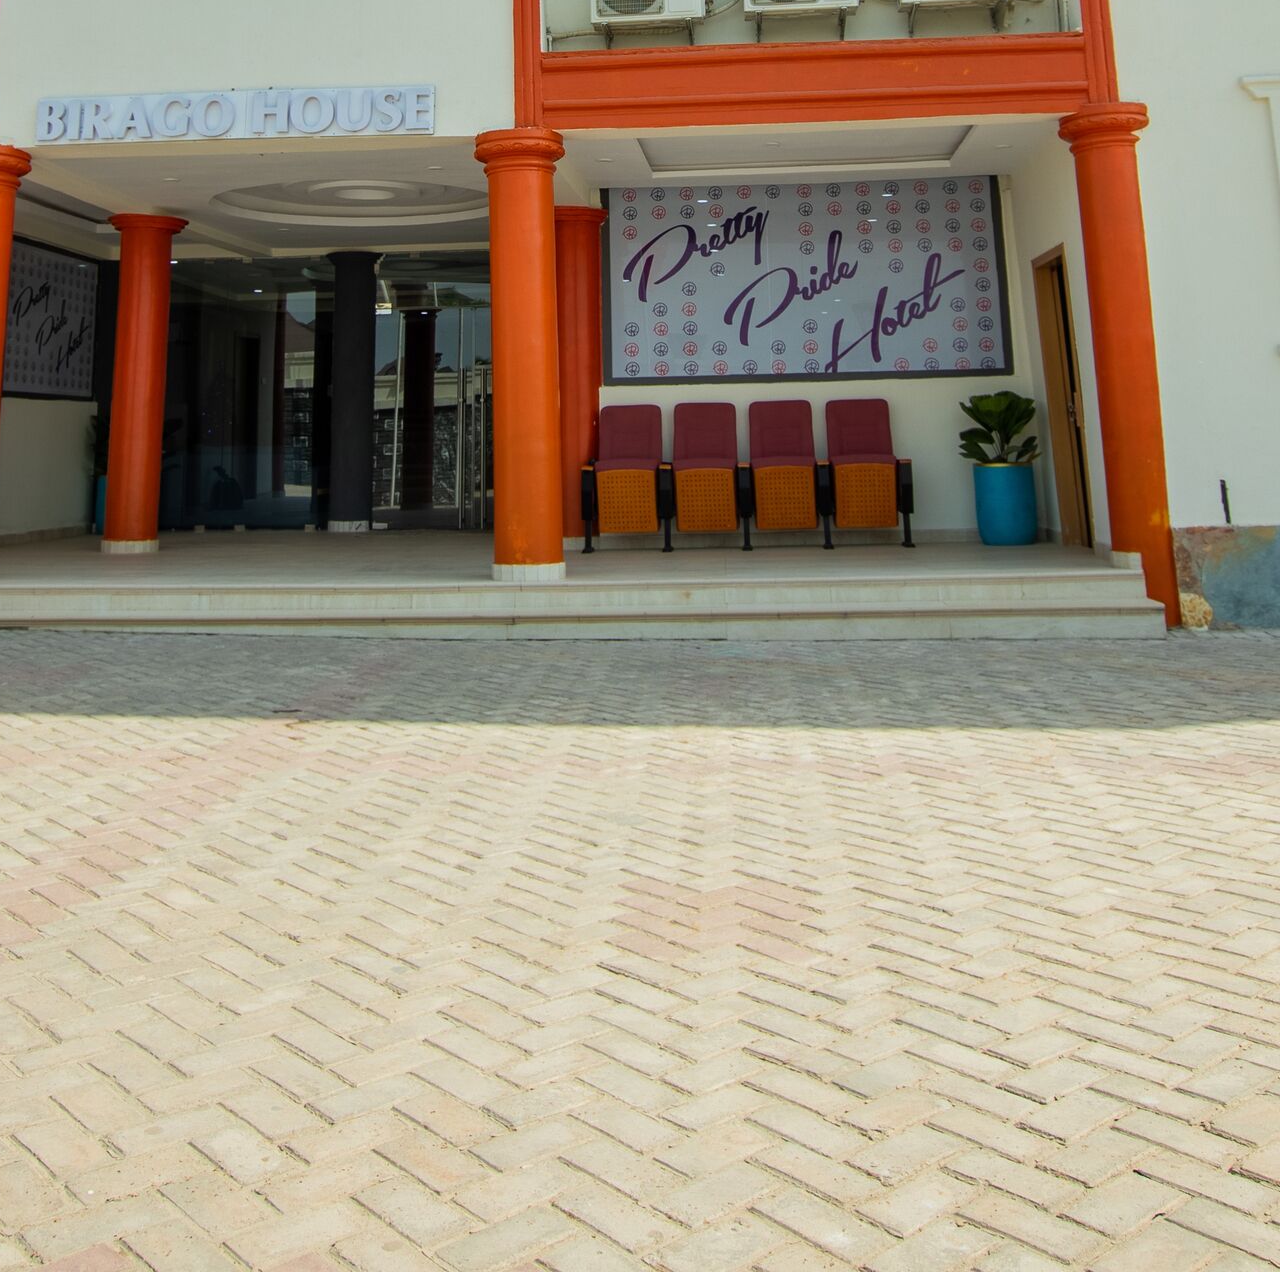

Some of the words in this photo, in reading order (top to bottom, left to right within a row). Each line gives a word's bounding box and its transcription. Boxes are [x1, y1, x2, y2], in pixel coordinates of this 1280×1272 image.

[36, 94, 235, 142] BIRAGO
[251, 87, 431, 133] HOUSE
[622, 205, 769, 303] Pretty
[723, 229, 859, 347] Pride
[824, 252, 966, 374] Hotel
